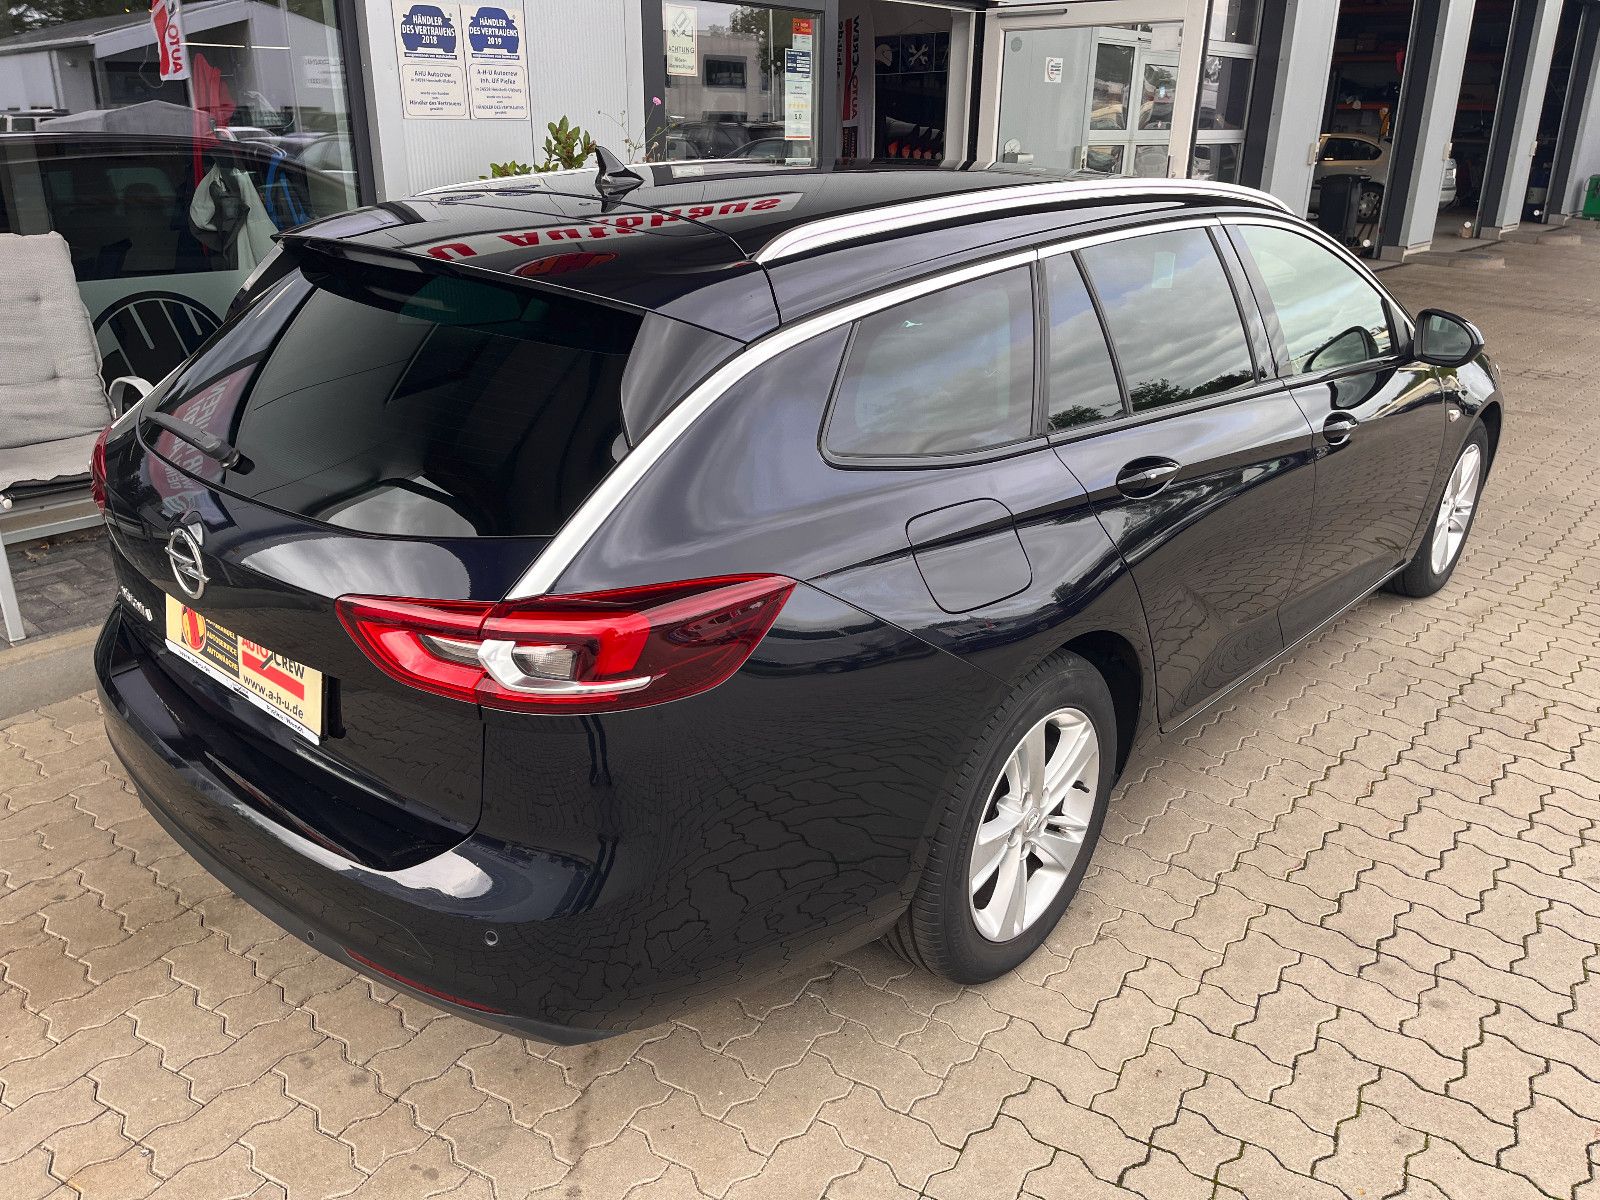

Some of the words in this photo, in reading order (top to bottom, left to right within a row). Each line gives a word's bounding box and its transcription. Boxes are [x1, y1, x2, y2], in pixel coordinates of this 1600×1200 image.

[412, 14, 442, 25] HÄNDLER
[480, 17, 506, 27] HÄNDLER
[402, 25, 414, 34] DES
[415, 25, 455, 36] VERTRAUENS
[481, 27, 518, 37] VERTRAUENS
[422, 36, 437, 44] 2018
[273, 651, 305, 680] CREW
[243, 674, 304, 719] www.a-h-u.de
